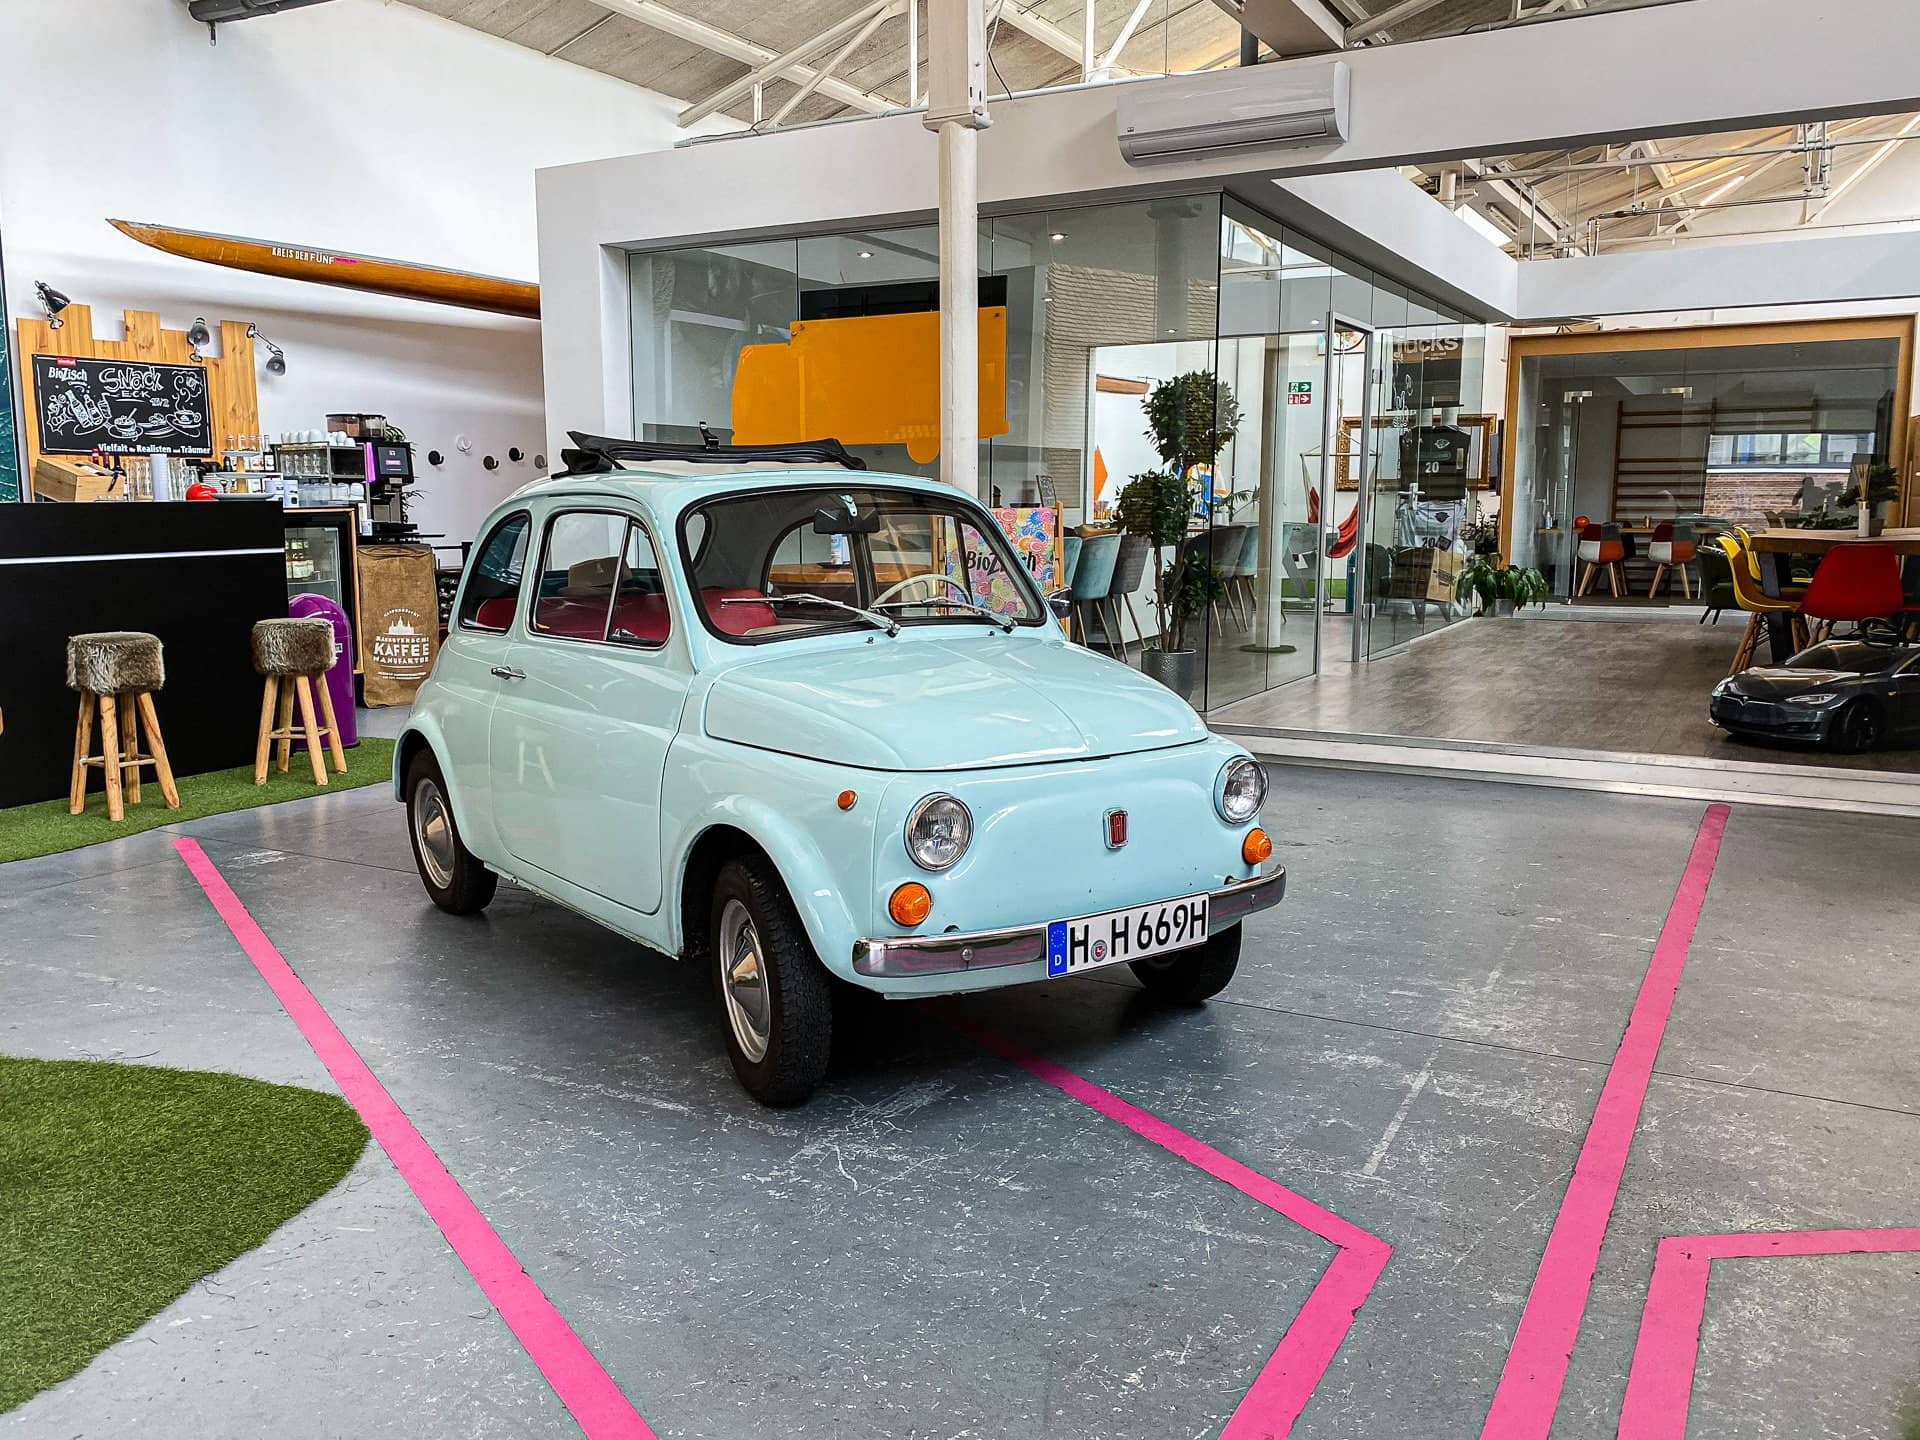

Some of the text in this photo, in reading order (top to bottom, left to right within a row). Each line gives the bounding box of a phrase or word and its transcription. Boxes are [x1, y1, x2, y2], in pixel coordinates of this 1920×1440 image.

[272, 247, 294, 258] KREIS
[295, 250, 309, 261] DER
[310, 251, 335, 264] FÜNF
[121, 390, 151, 398] ECK
[97, 443, 128, 453] Vielfalt
[136, 444, 172, 453] Realisten
[181, 446, 211, 454] Träumer
[1425, 461, 1439, 473] 20
[374, 642, 429, 657] KAFFEE
[1069, 899, 1207, 966] H H 669H
[1054, 954, 1062, 966] D
